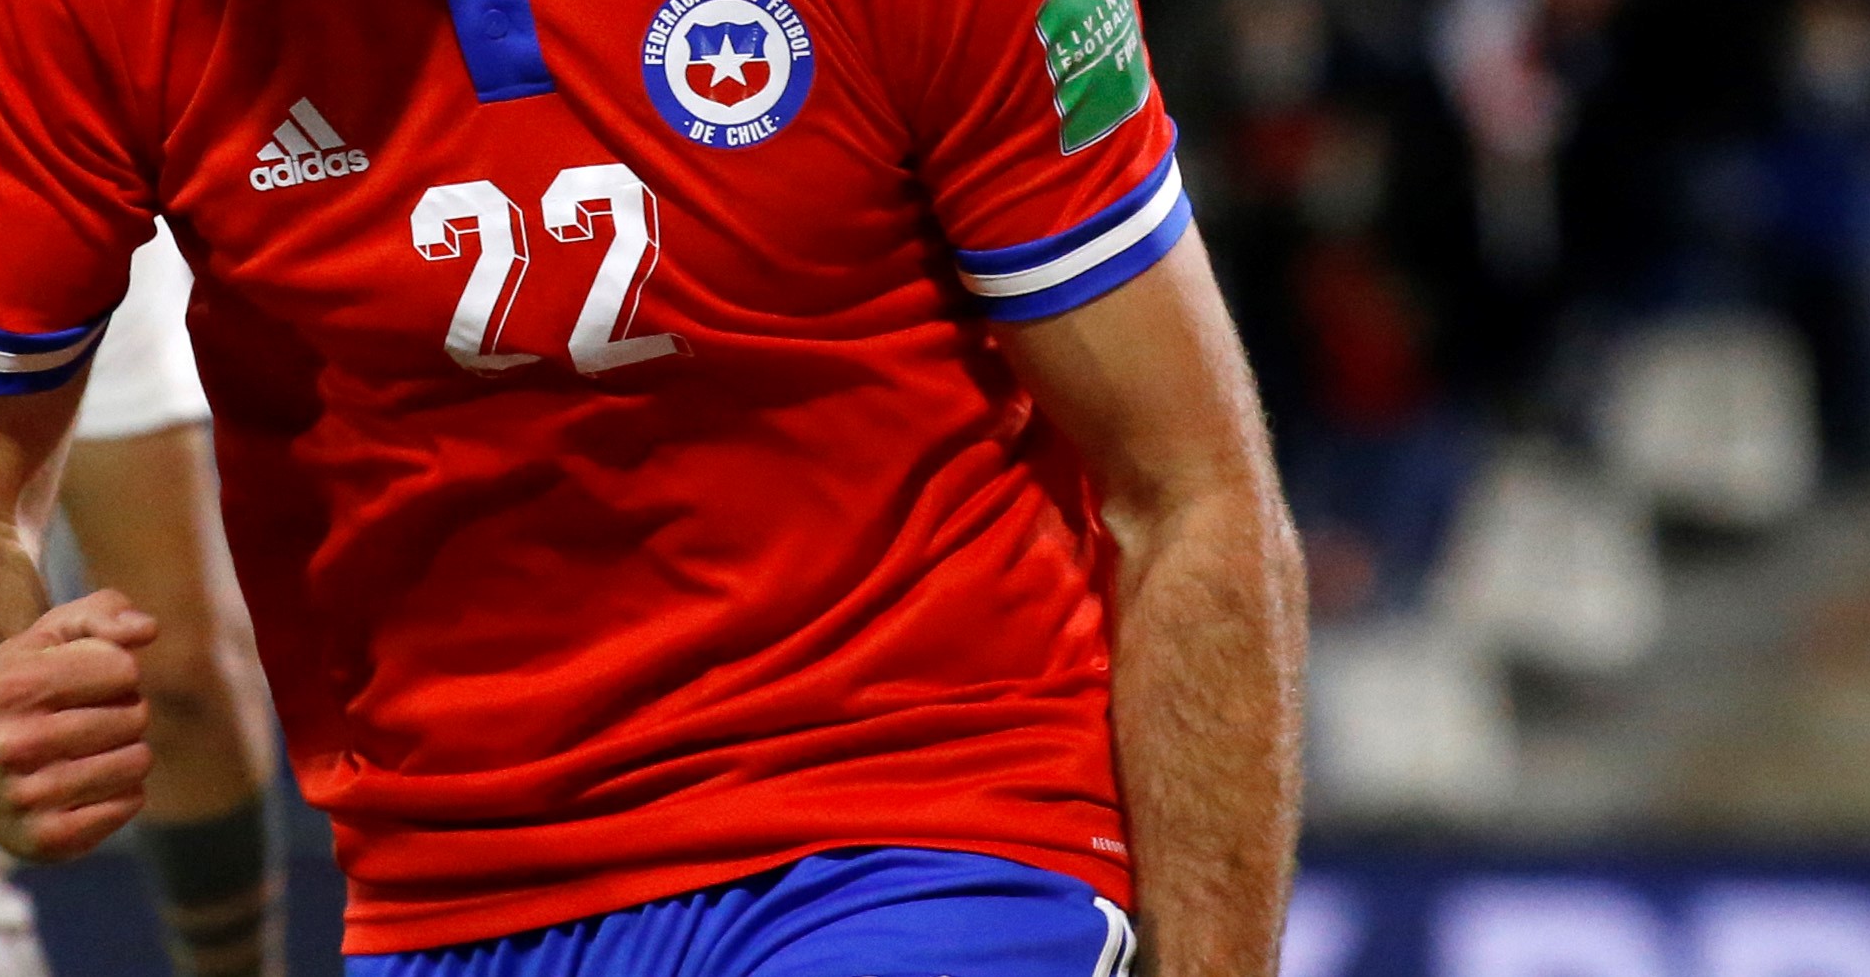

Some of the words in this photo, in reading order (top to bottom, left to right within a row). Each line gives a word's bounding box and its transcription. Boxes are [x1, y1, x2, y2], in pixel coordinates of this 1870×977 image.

[688, 120, 716, 144] DE
[726, 114, 778, 147] CHILE
[249, 144, 370, 192] adidas
[410, 163, 695, 379] 22
